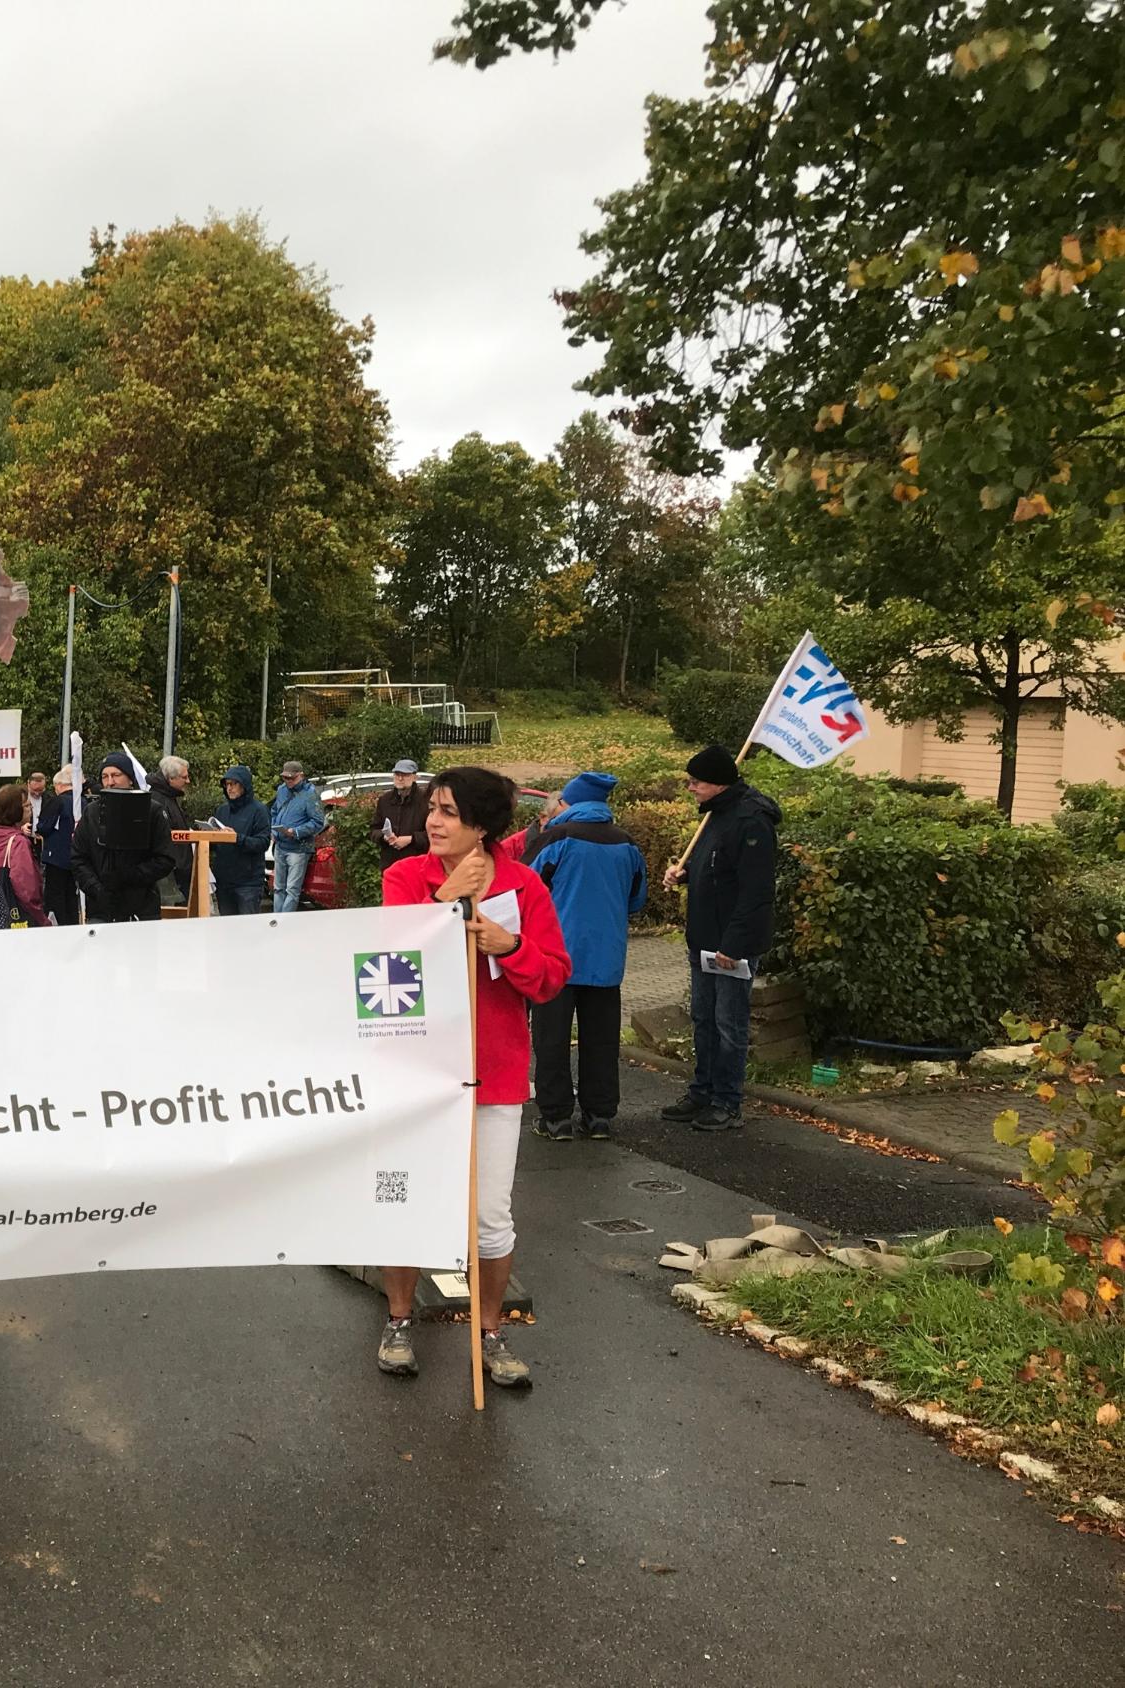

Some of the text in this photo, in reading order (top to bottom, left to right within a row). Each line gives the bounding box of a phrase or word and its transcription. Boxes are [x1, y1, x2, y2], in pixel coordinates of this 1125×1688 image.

[807, 731, 833, 756] und
[358, 1021, 426, 1030] Arbeitnehmerpastoral
[358, 1029, 427, 1038] Erzbistum Bamberg
[72, 1110, 88, 1119] -
[100, 1084, 230, 1129] Profit
[240, 1074, 367, 1120] nicht!
